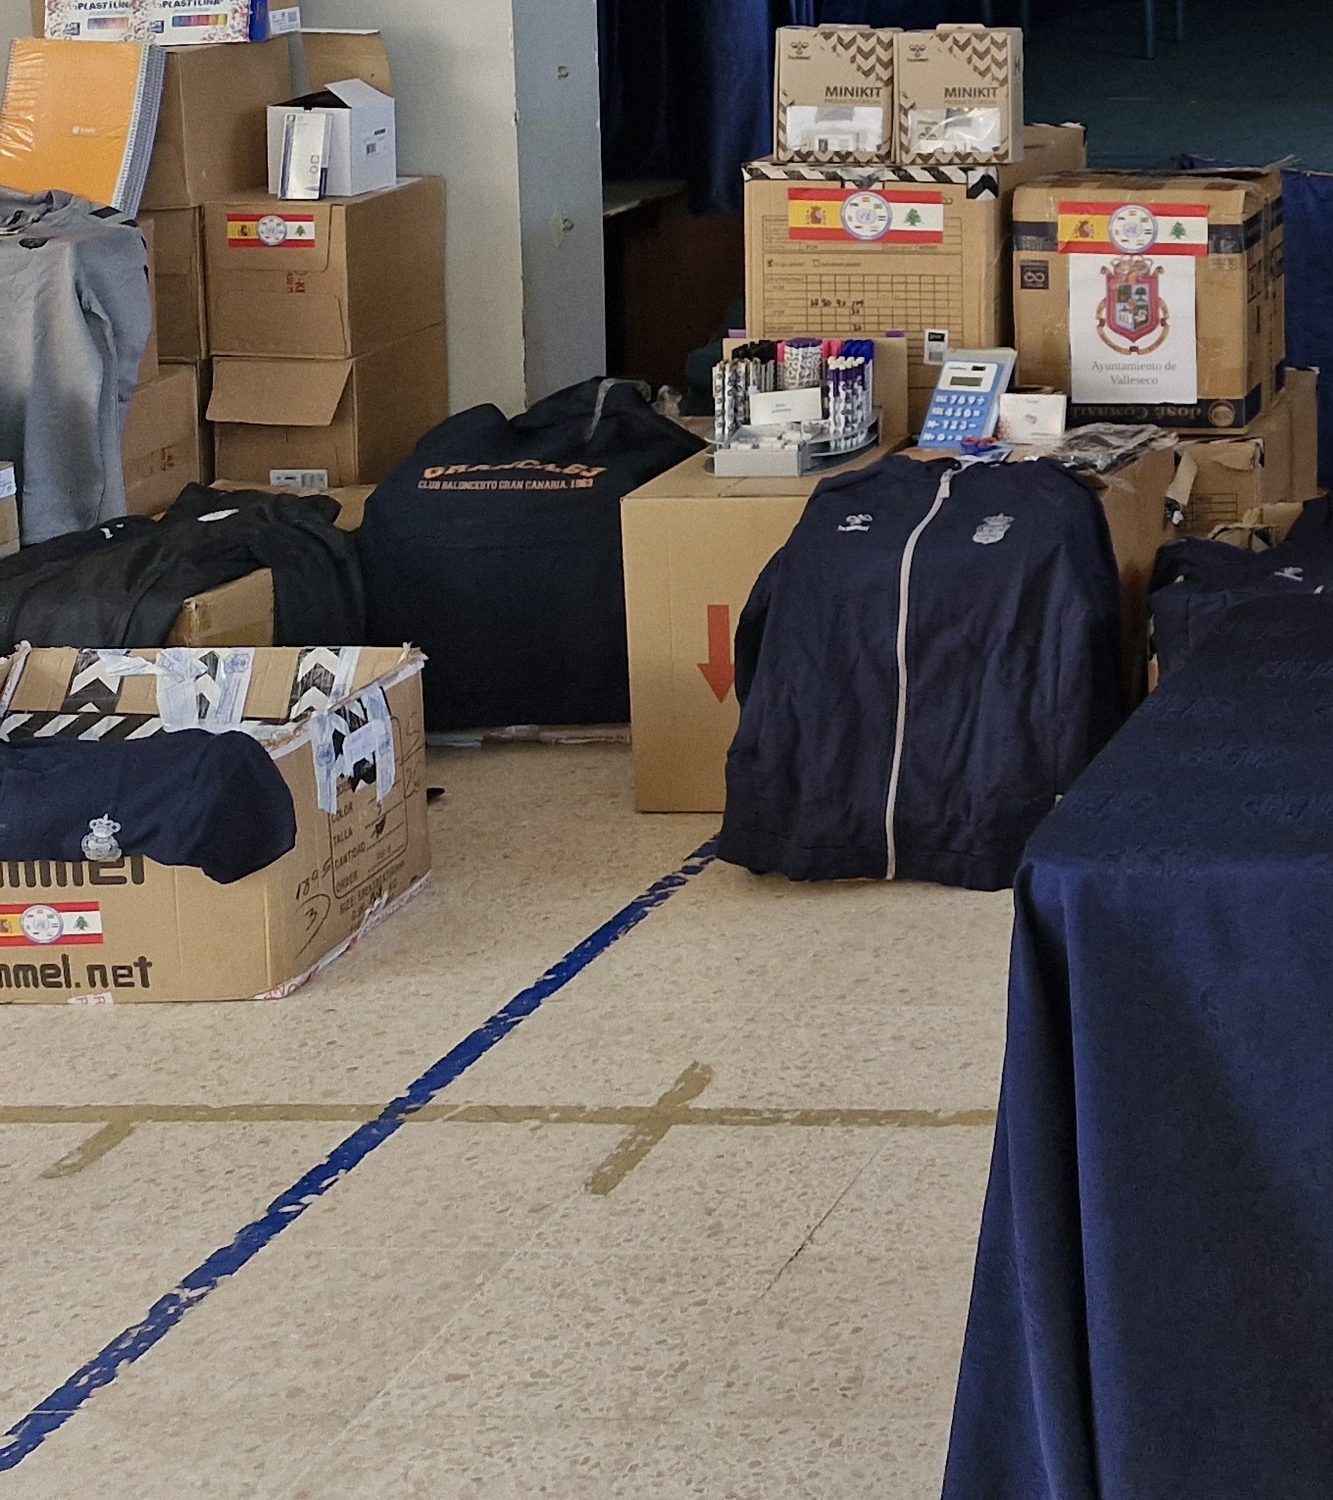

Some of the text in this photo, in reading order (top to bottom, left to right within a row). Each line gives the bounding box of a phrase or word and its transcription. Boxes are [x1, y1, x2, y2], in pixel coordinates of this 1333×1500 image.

[825, 85, 883, 98] MINIKIT
[944, 86, 999, 99] MINIKIT
[1091, 360, 1177, 374] Ayuntamiento de
[1110, 374, 1159, 386] Valleseco
[417, 480, 441, 489] CLUB
[498, 480, 524, 490] GRAN
[331, 801, 354, 823] COLOR
[333, 826, 354, 846] TALLA
[334, 841, 366, 870] CANTIDAD
